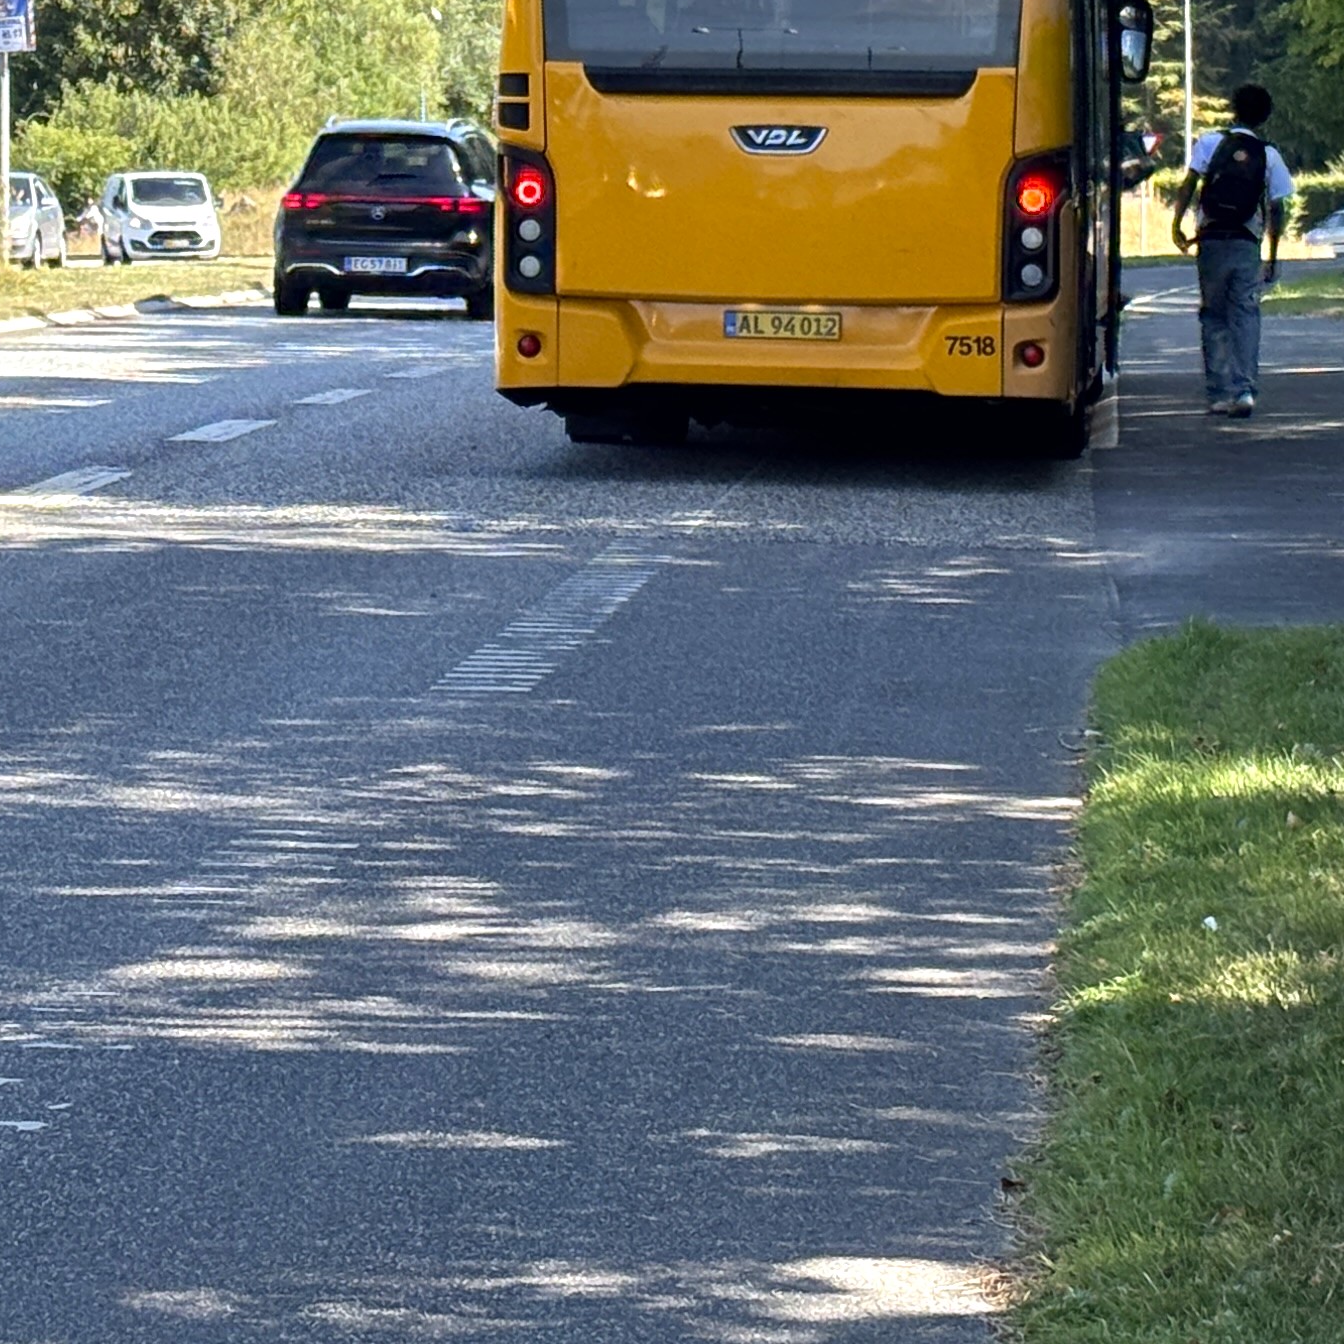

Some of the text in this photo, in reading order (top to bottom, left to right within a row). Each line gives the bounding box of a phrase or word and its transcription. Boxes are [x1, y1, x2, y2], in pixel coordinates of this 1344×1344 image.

[747, 129, 808, 146] VDL
[738, 315, 838, 337] AL 94 012
[945, 336, 996, 356] 7518
